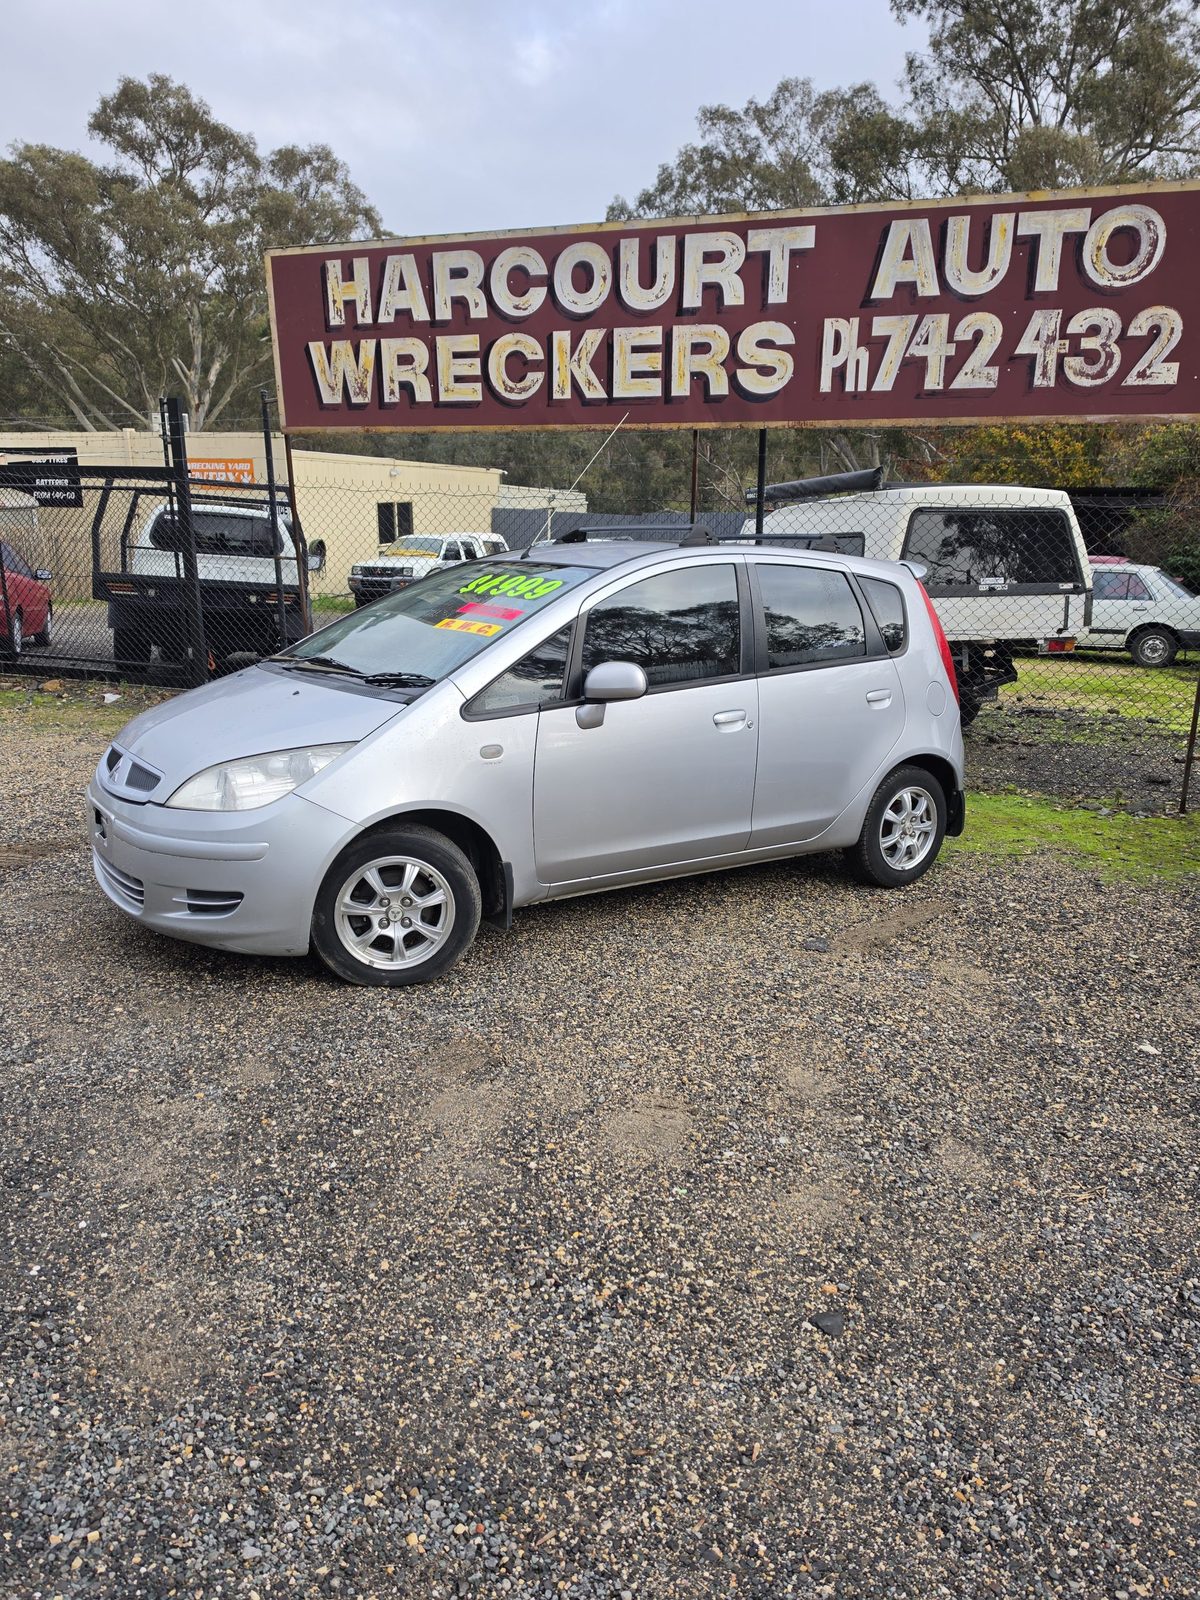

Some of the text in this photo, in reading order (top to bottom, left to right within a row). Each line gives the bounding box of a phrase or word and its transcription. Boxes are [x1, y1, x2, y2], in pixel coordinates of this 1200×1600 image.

[324, 203, 1167, 327] HARCOURT AUTO
[307, 320, 796, 404] WRECKERS
[226, 462, 251, 471] YARD
